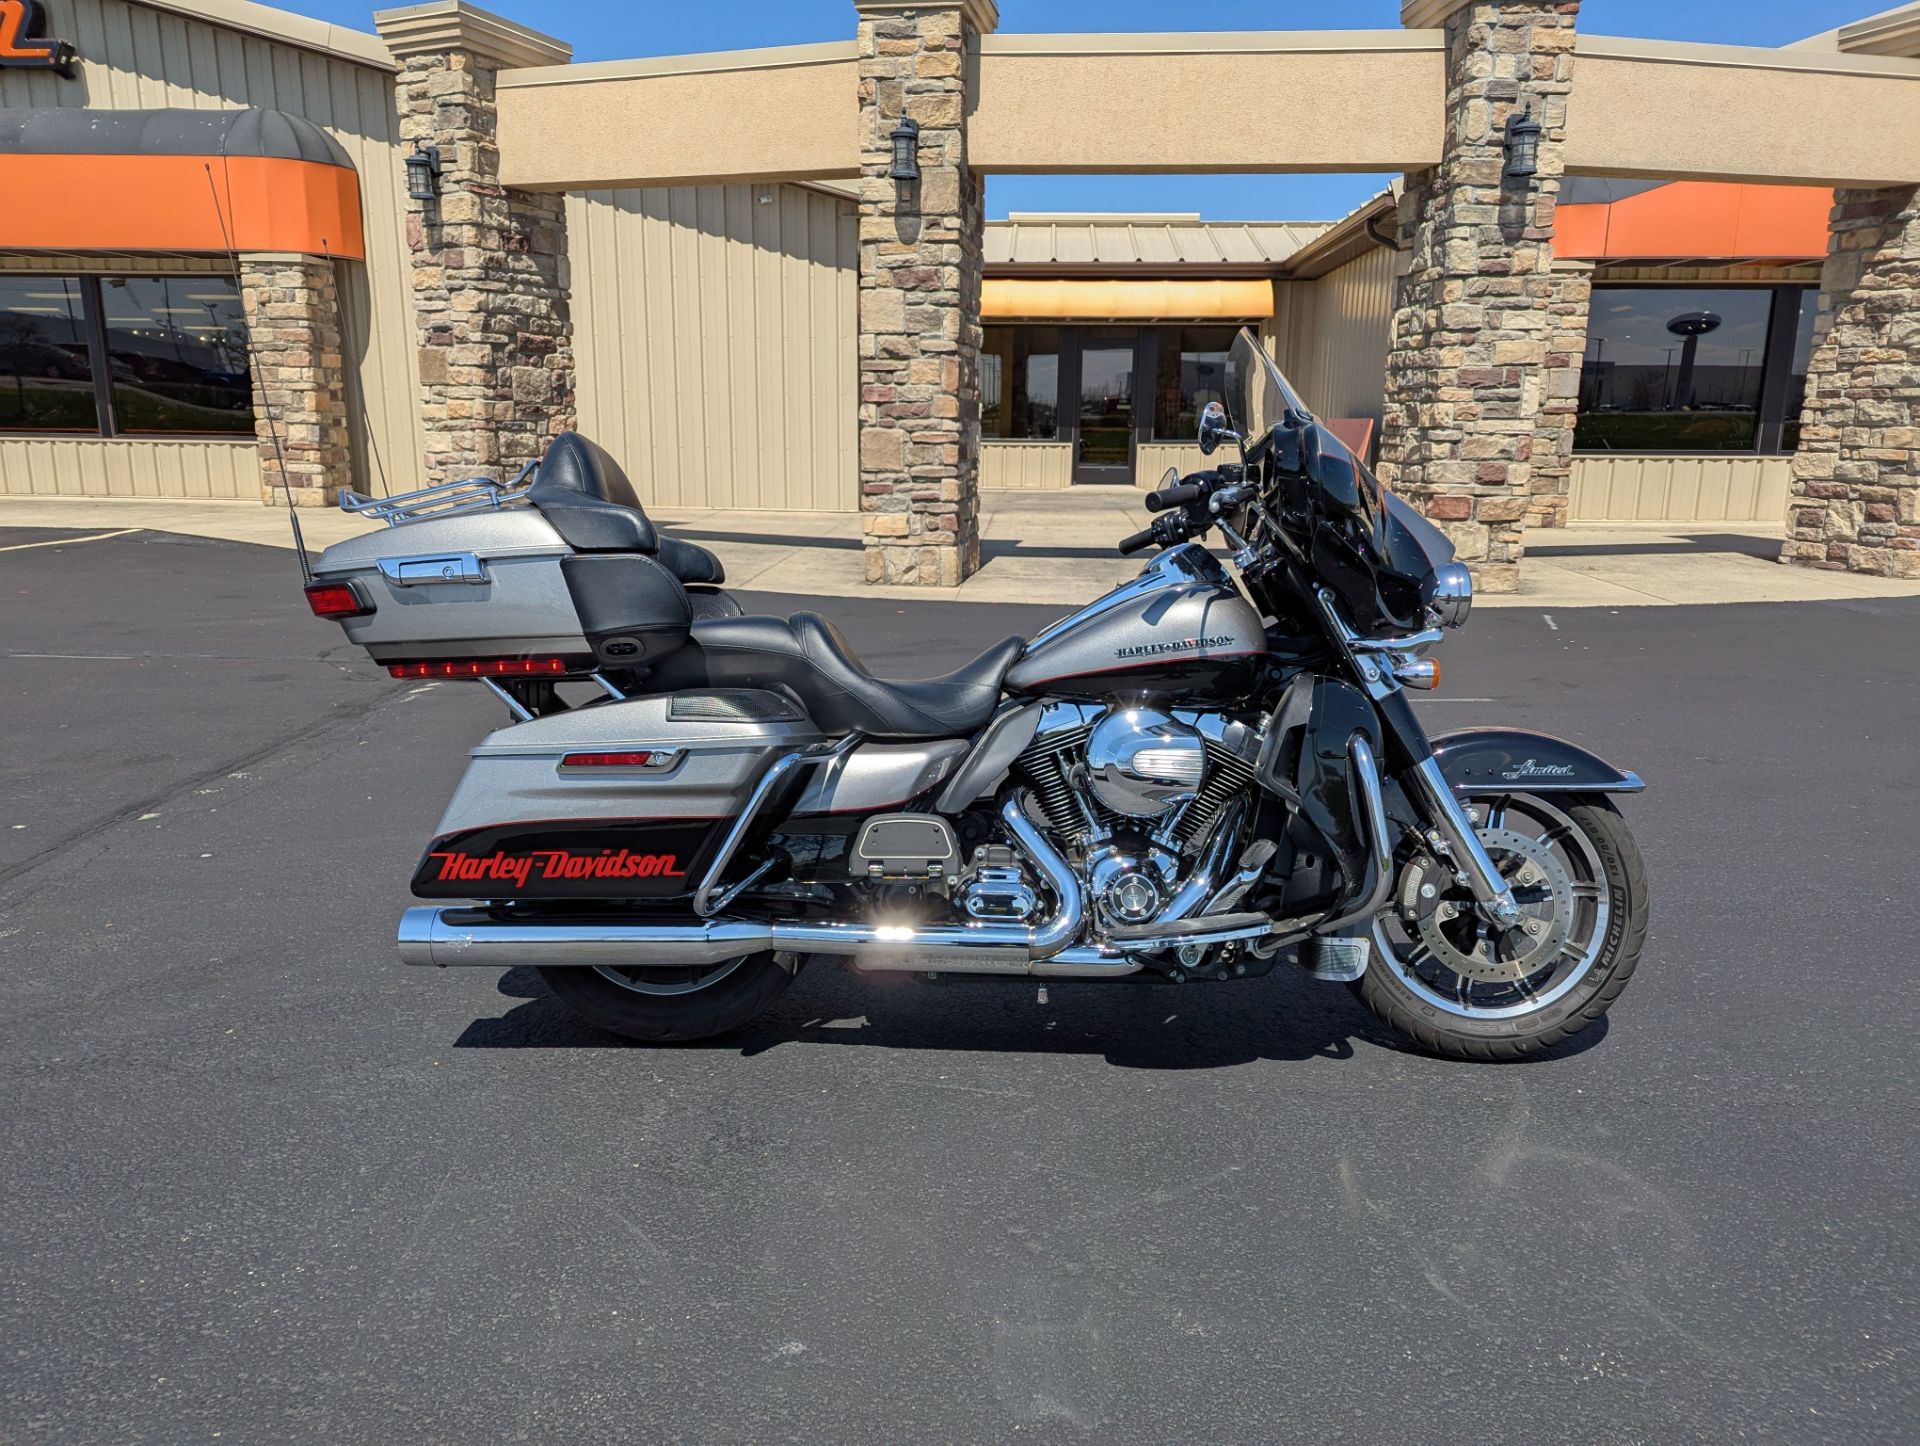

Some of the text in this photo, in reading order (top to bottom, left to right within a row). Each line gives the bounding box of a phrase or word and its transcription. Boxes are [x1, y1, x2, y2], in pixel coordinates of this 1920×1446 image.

[1502, 759, 1575, 779] Limited
[429, 849, 686, 888] Harley-Davidson
[1601, 886, 1624, 967] MICHELIN
